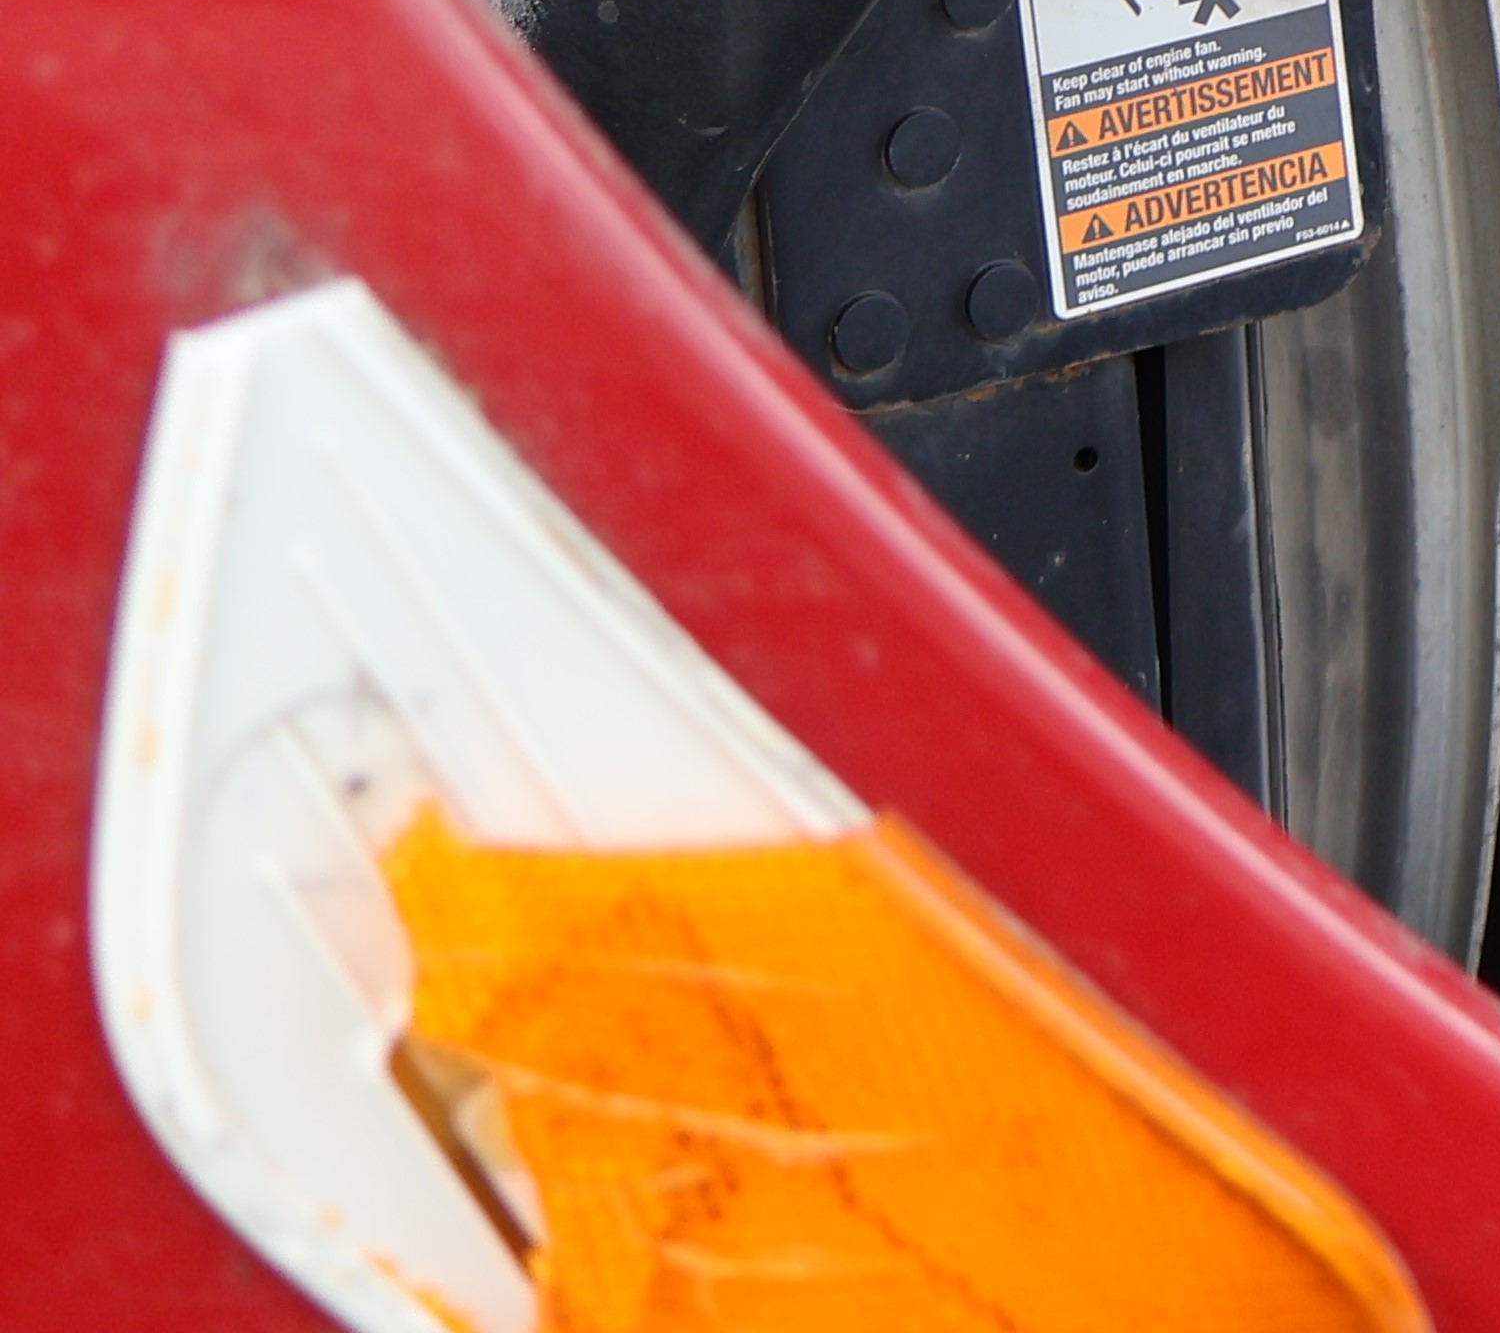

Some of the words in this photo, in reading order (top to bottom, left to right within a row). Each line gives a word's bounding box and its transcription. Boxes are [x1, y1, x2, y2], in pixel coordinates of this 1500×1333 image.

[1052, 73, 1088, 94] Keep
[1091, 64, 1125, 85] clear
[1128, 56, 1144, 73] of
[1146, 44, 1192, 70] engine
[1195, 38, 1222, 58] fan.
[1055, 90, 1081, 112] Fan
[1084, 85, 1114, 106] may
[1117, 74, 1150, 95] start
[1152, 62, 1205, 86] without
[1207, 45, 1267, 72] warning.
[1098, 53, 1329, 140] AVERTISSEMENT
[1062, 153, 1109, 176] Restez
[1124, 135, 1169, 159] l'écart
[1171, 129, 1190, 146] du
[1192, 109, 1265, 140] ventilateur
[1267, 104, 1286, 122] du
[1065, 169, 1117, 193] moteur.
[1119, 153, 1172, 180] Celui-ci
[1175, 137, 1230, 167] pourrait
[1232, 132, 1249, 147] se
[1252, 120, 1296, 144] mettre
[1066, 175, 1165, 211] soudainement
[1167, 167, 1184, 183] en
[1187, 153, 1243, 179] marche.
[1124, 151, 1329, 233] ADVERTENCIA
[1073, 235, 1158, 271] Mantengase
[1161, 223, 1211, 247] alejado
[1213, 215, 1235, 233] del
[1237, 194, 1304, 226] ventilador
[1307, 186, 1329, 206] del
[1075, 264, 1121, 288] motor,
[1122, 252, 1165, 278] puede
[1167, 237, 1225, 261] arrancar
[1228, 227, 1250, 245] sin
[1252, 216, 1294, 242] previo
[1078, 283, 1120, 304] aviso.
